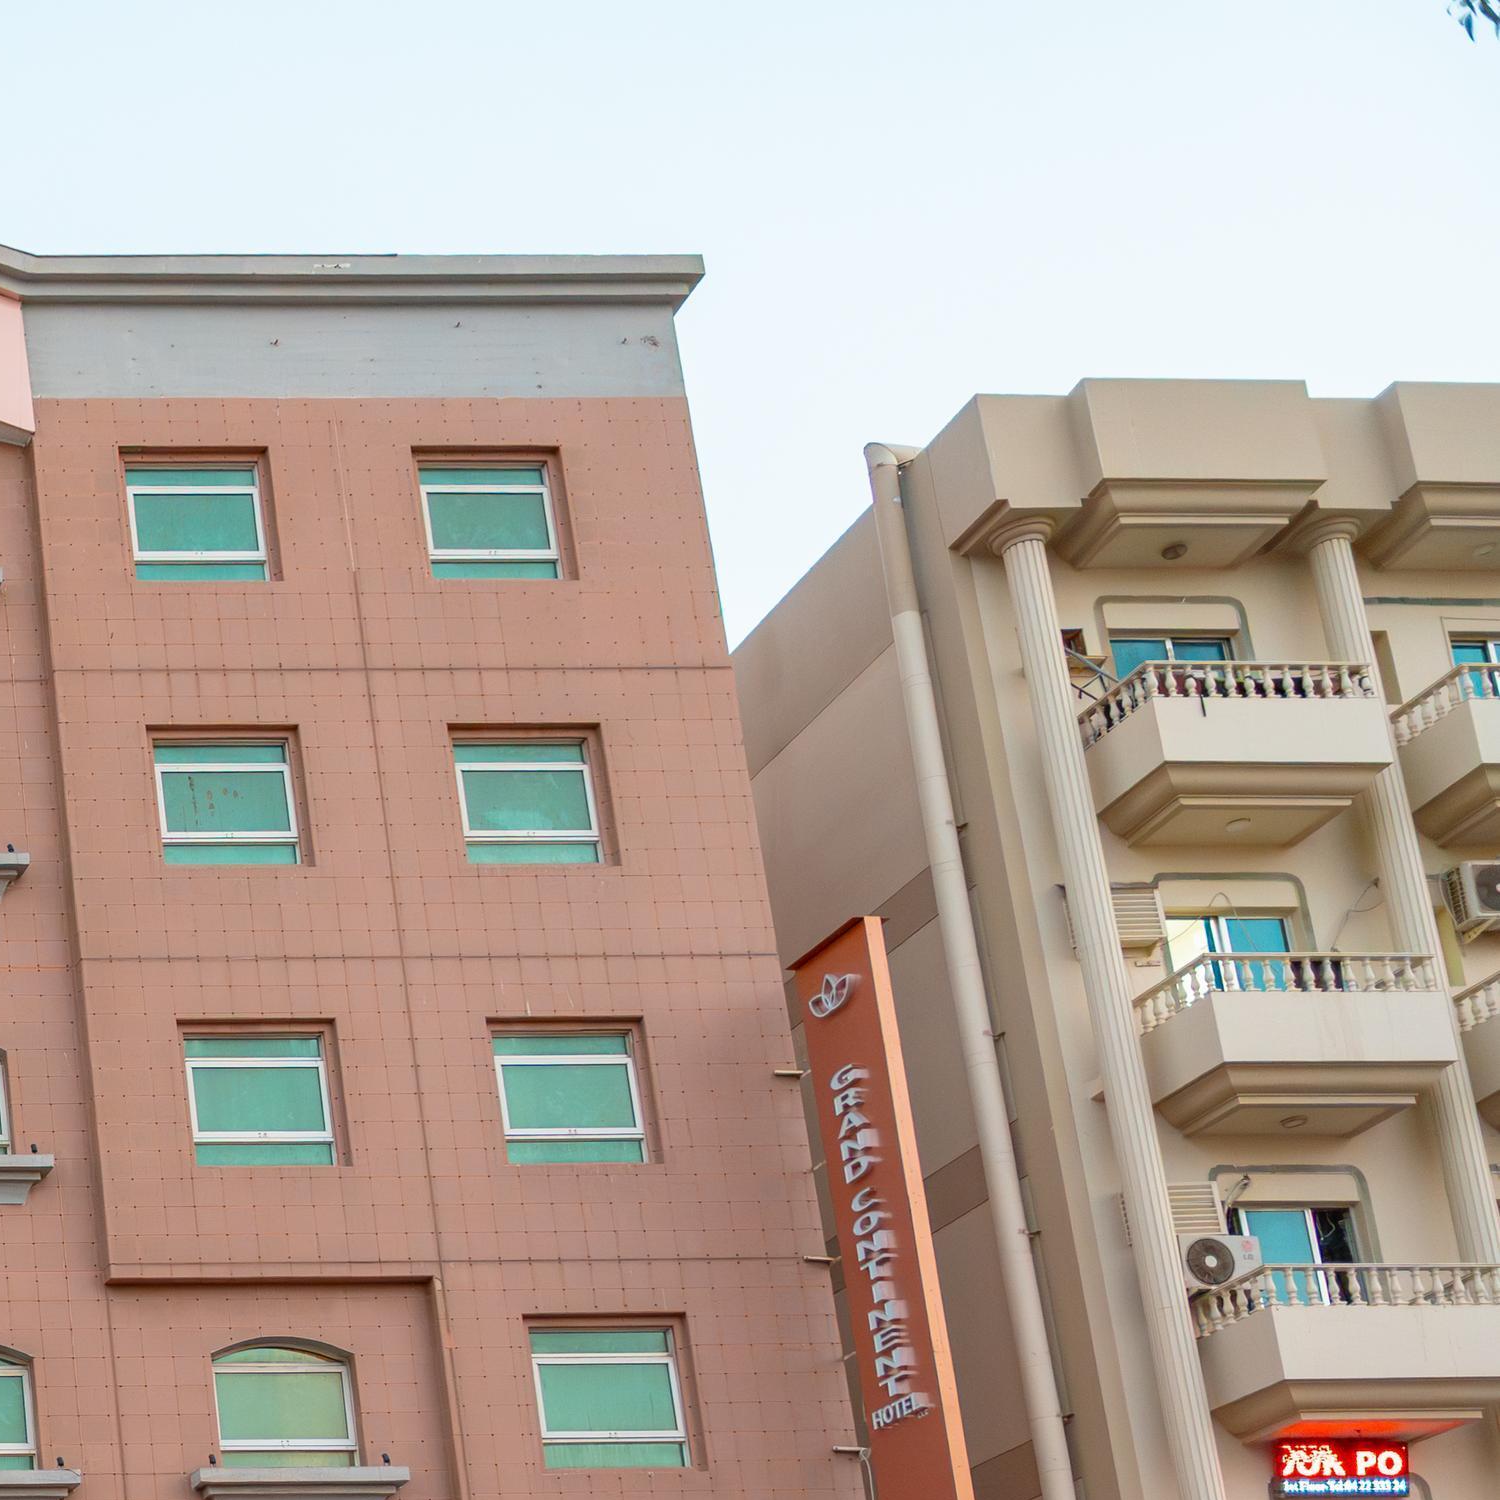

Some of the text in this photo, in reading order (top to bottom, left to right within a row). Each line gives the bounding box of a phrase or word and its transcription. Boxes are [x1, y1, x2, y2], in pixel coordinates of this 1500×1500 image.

[830, 1064, 916, 1398] GRAND CONTINENT
[872, 1392, 926, 1431] HOTEL
